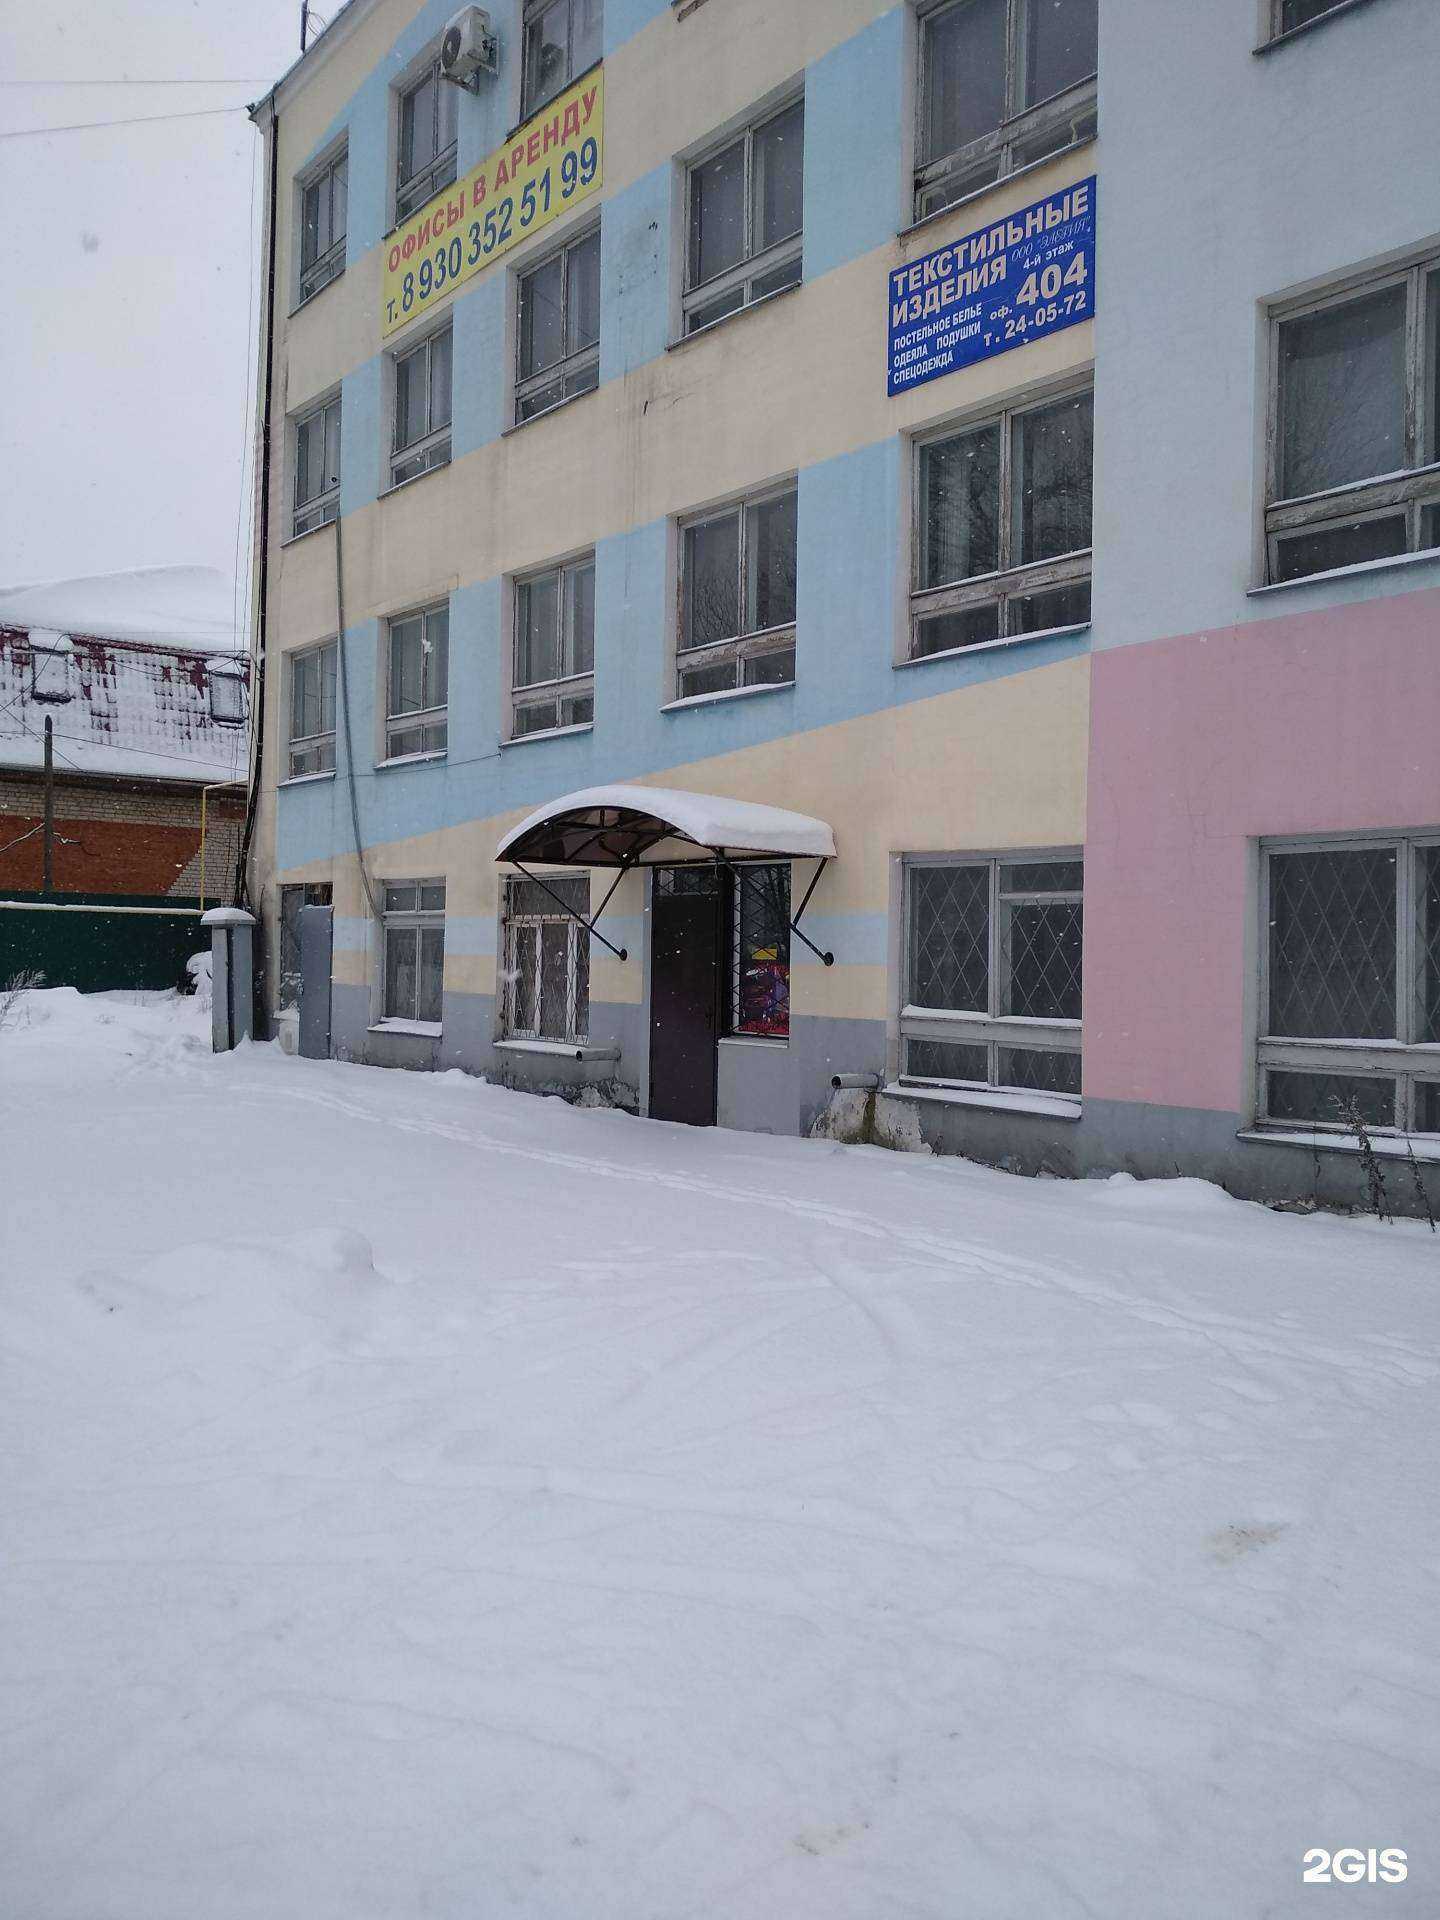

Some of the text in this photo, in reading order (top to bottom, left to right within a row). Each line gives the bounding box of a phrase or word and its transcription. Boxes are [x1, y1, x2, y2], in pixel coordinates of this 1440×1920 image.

[388, 86, 598, 273] ОФИСЫ В АРЕНДУ
[468, 197, 514, 266] 352
[520, 167, 551, 227] 51
[561, 136, 599, 199] 99
[893, 185, 1089, 297] ТЕКСТИЛЬНЫЕ
[1011, 240, 1033, 262] ООО
[1023, 240, 1074, 270] 4-й этаж
[893, 255, 1007, 328] ИЗДЕЛИЯ
[989, 252, 1088, 321] оф. 404
[894, 302, 984, 351] ПОСТЕЛЬНОЕ БЕЛЬЕ
[1005, 291, 1087, 340] 24-05-72
[893, 321, 981, 368] ОДЕЯЛА ПОДУШКИ
[893, 351, 954, 385] СПЕЦОДЕЖДА
